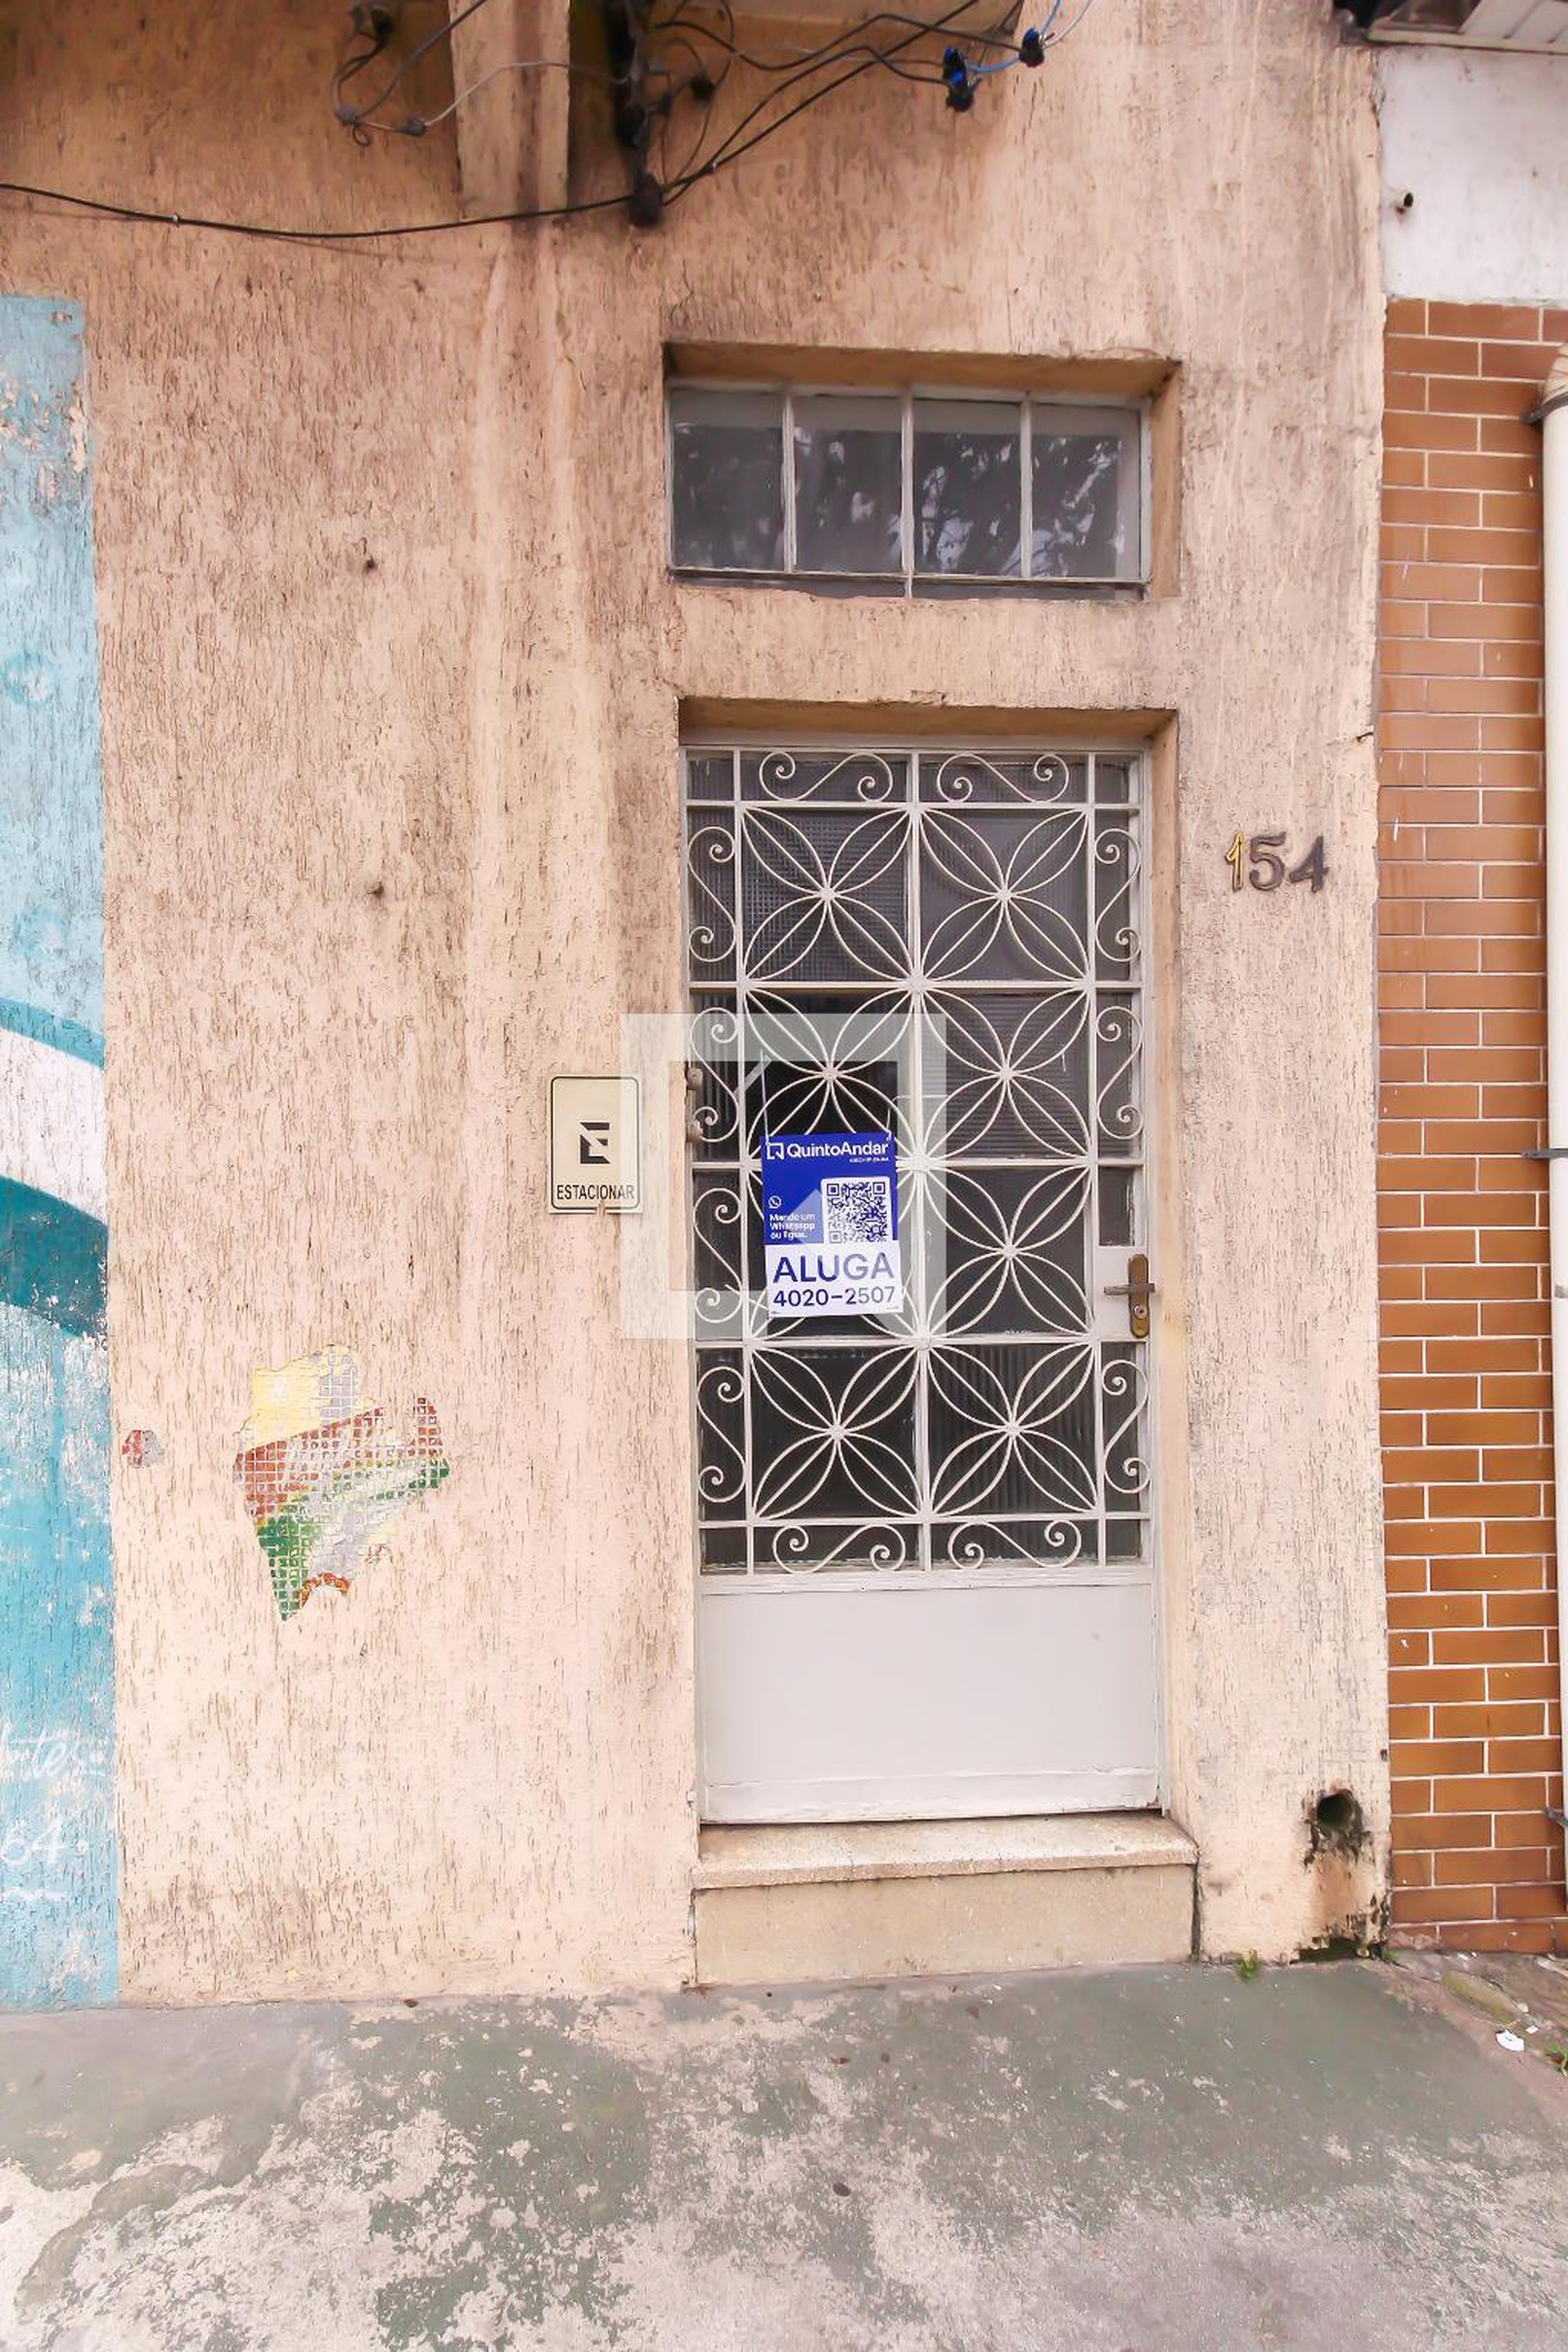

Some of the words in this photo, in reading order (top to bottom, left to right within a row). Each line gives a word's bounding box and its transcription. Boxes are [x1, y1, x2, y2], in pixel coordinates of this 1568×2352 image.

[1225, 831, 1329, 893] 154
[787, 1140, 889, 1158] QuintoAndar
[557, 1185, 635, 1200] ESTACIONAR
[773, 1252, 895, 1283] ALUGA
[773, 1286, 895, 1307] 4020-2507
